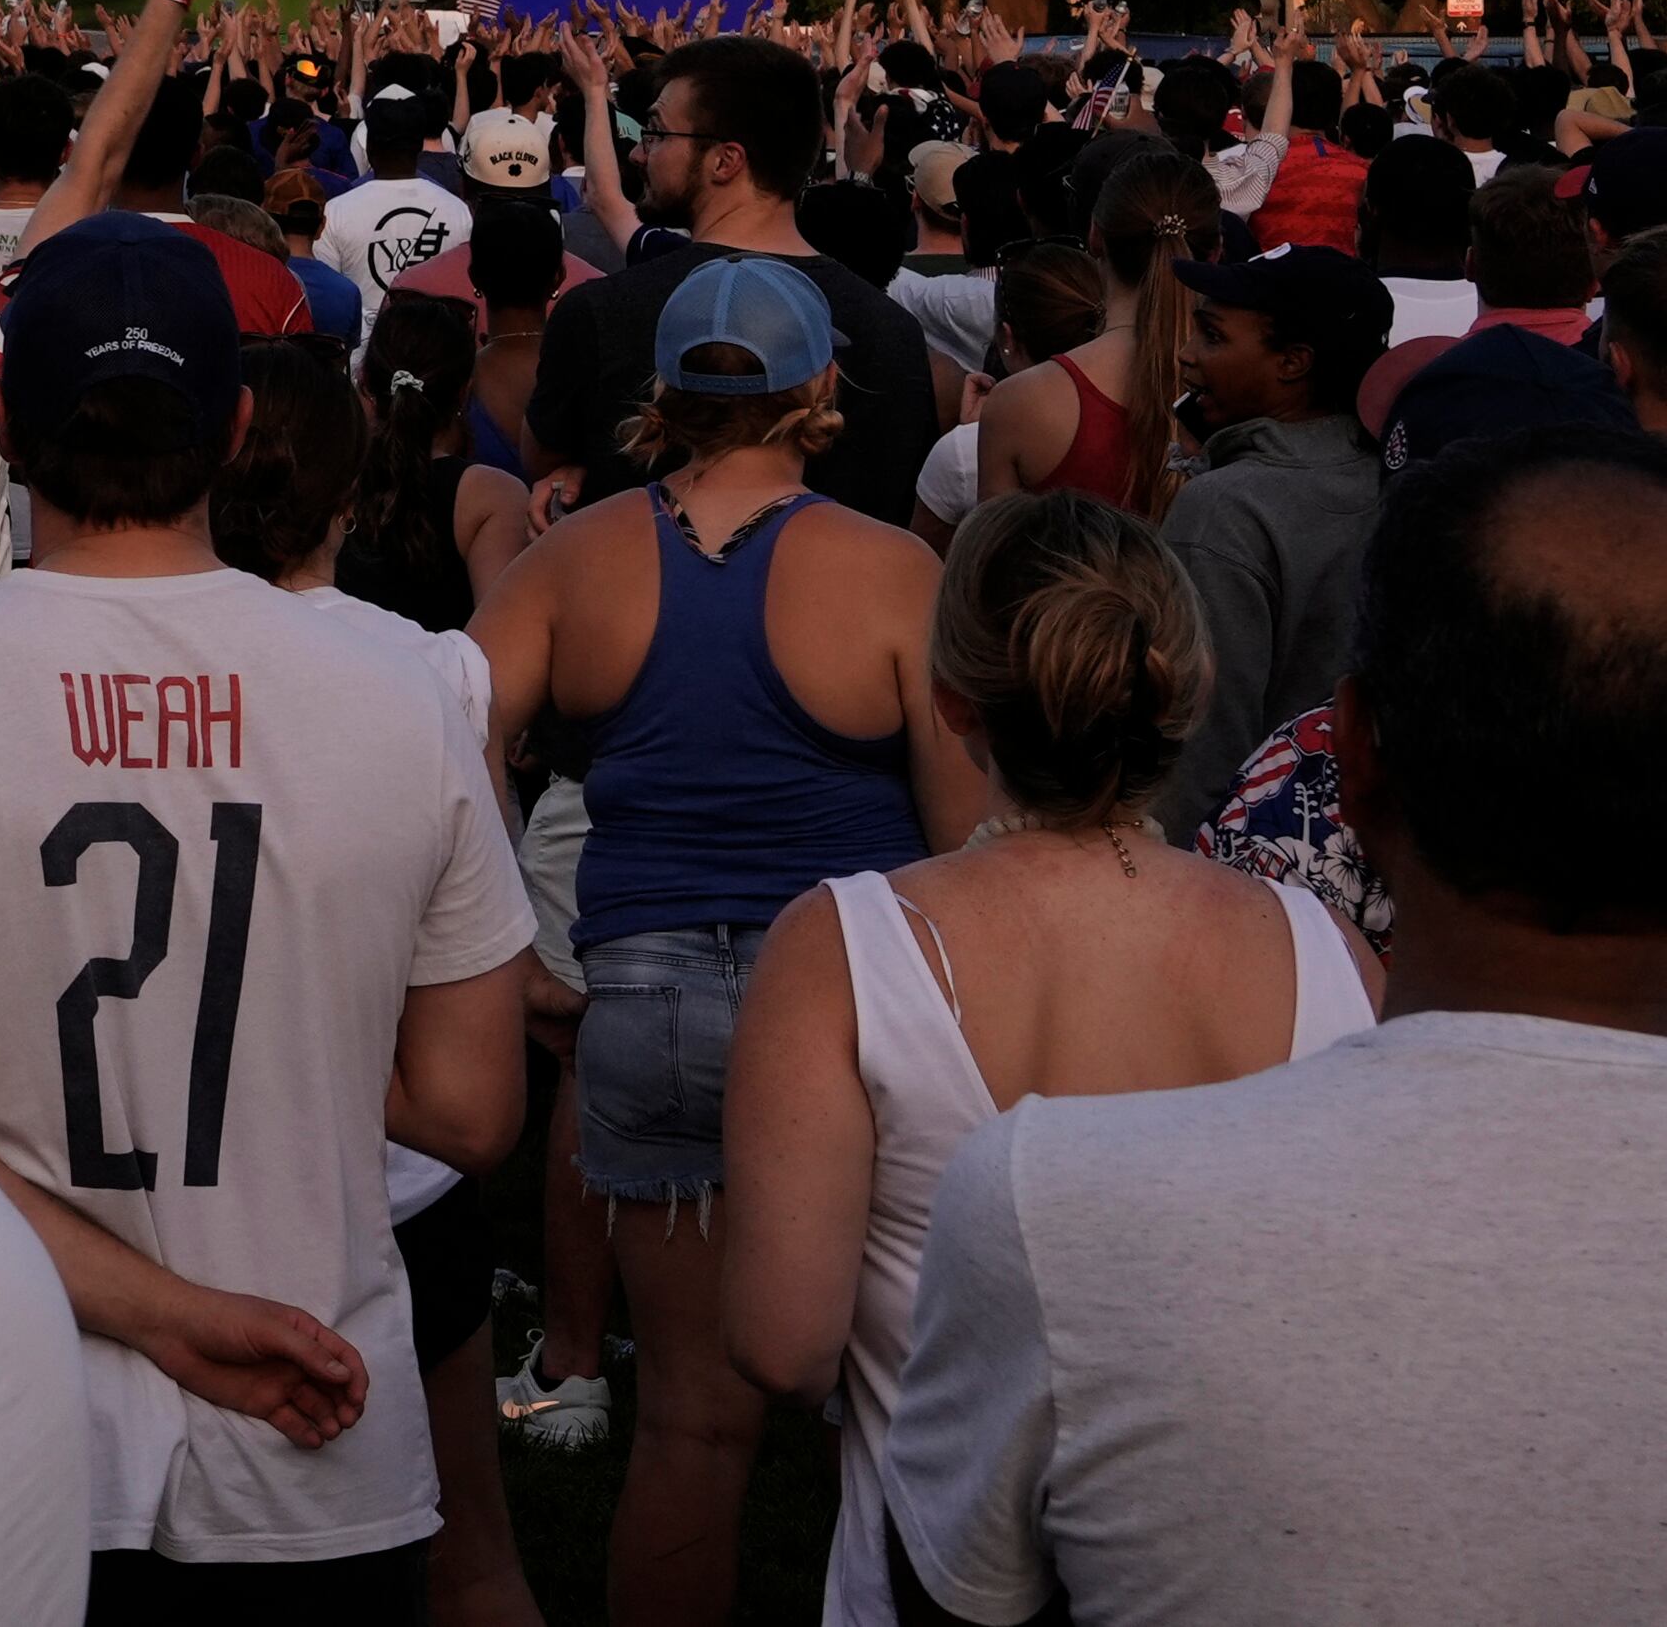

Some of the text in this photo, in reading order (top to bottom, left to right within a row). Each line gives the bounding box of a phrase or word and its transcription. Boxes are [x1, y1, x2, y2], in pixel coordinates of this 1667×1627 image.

[490, 151, 539, 166] BLACK CLOVER
[125, 326, 148, 340] 250
[84, 340, 186, 367] YEARS OF FREEDOM
[60, 672, 242, 769] WEAH
[39, 802, 263, 1193] 21
